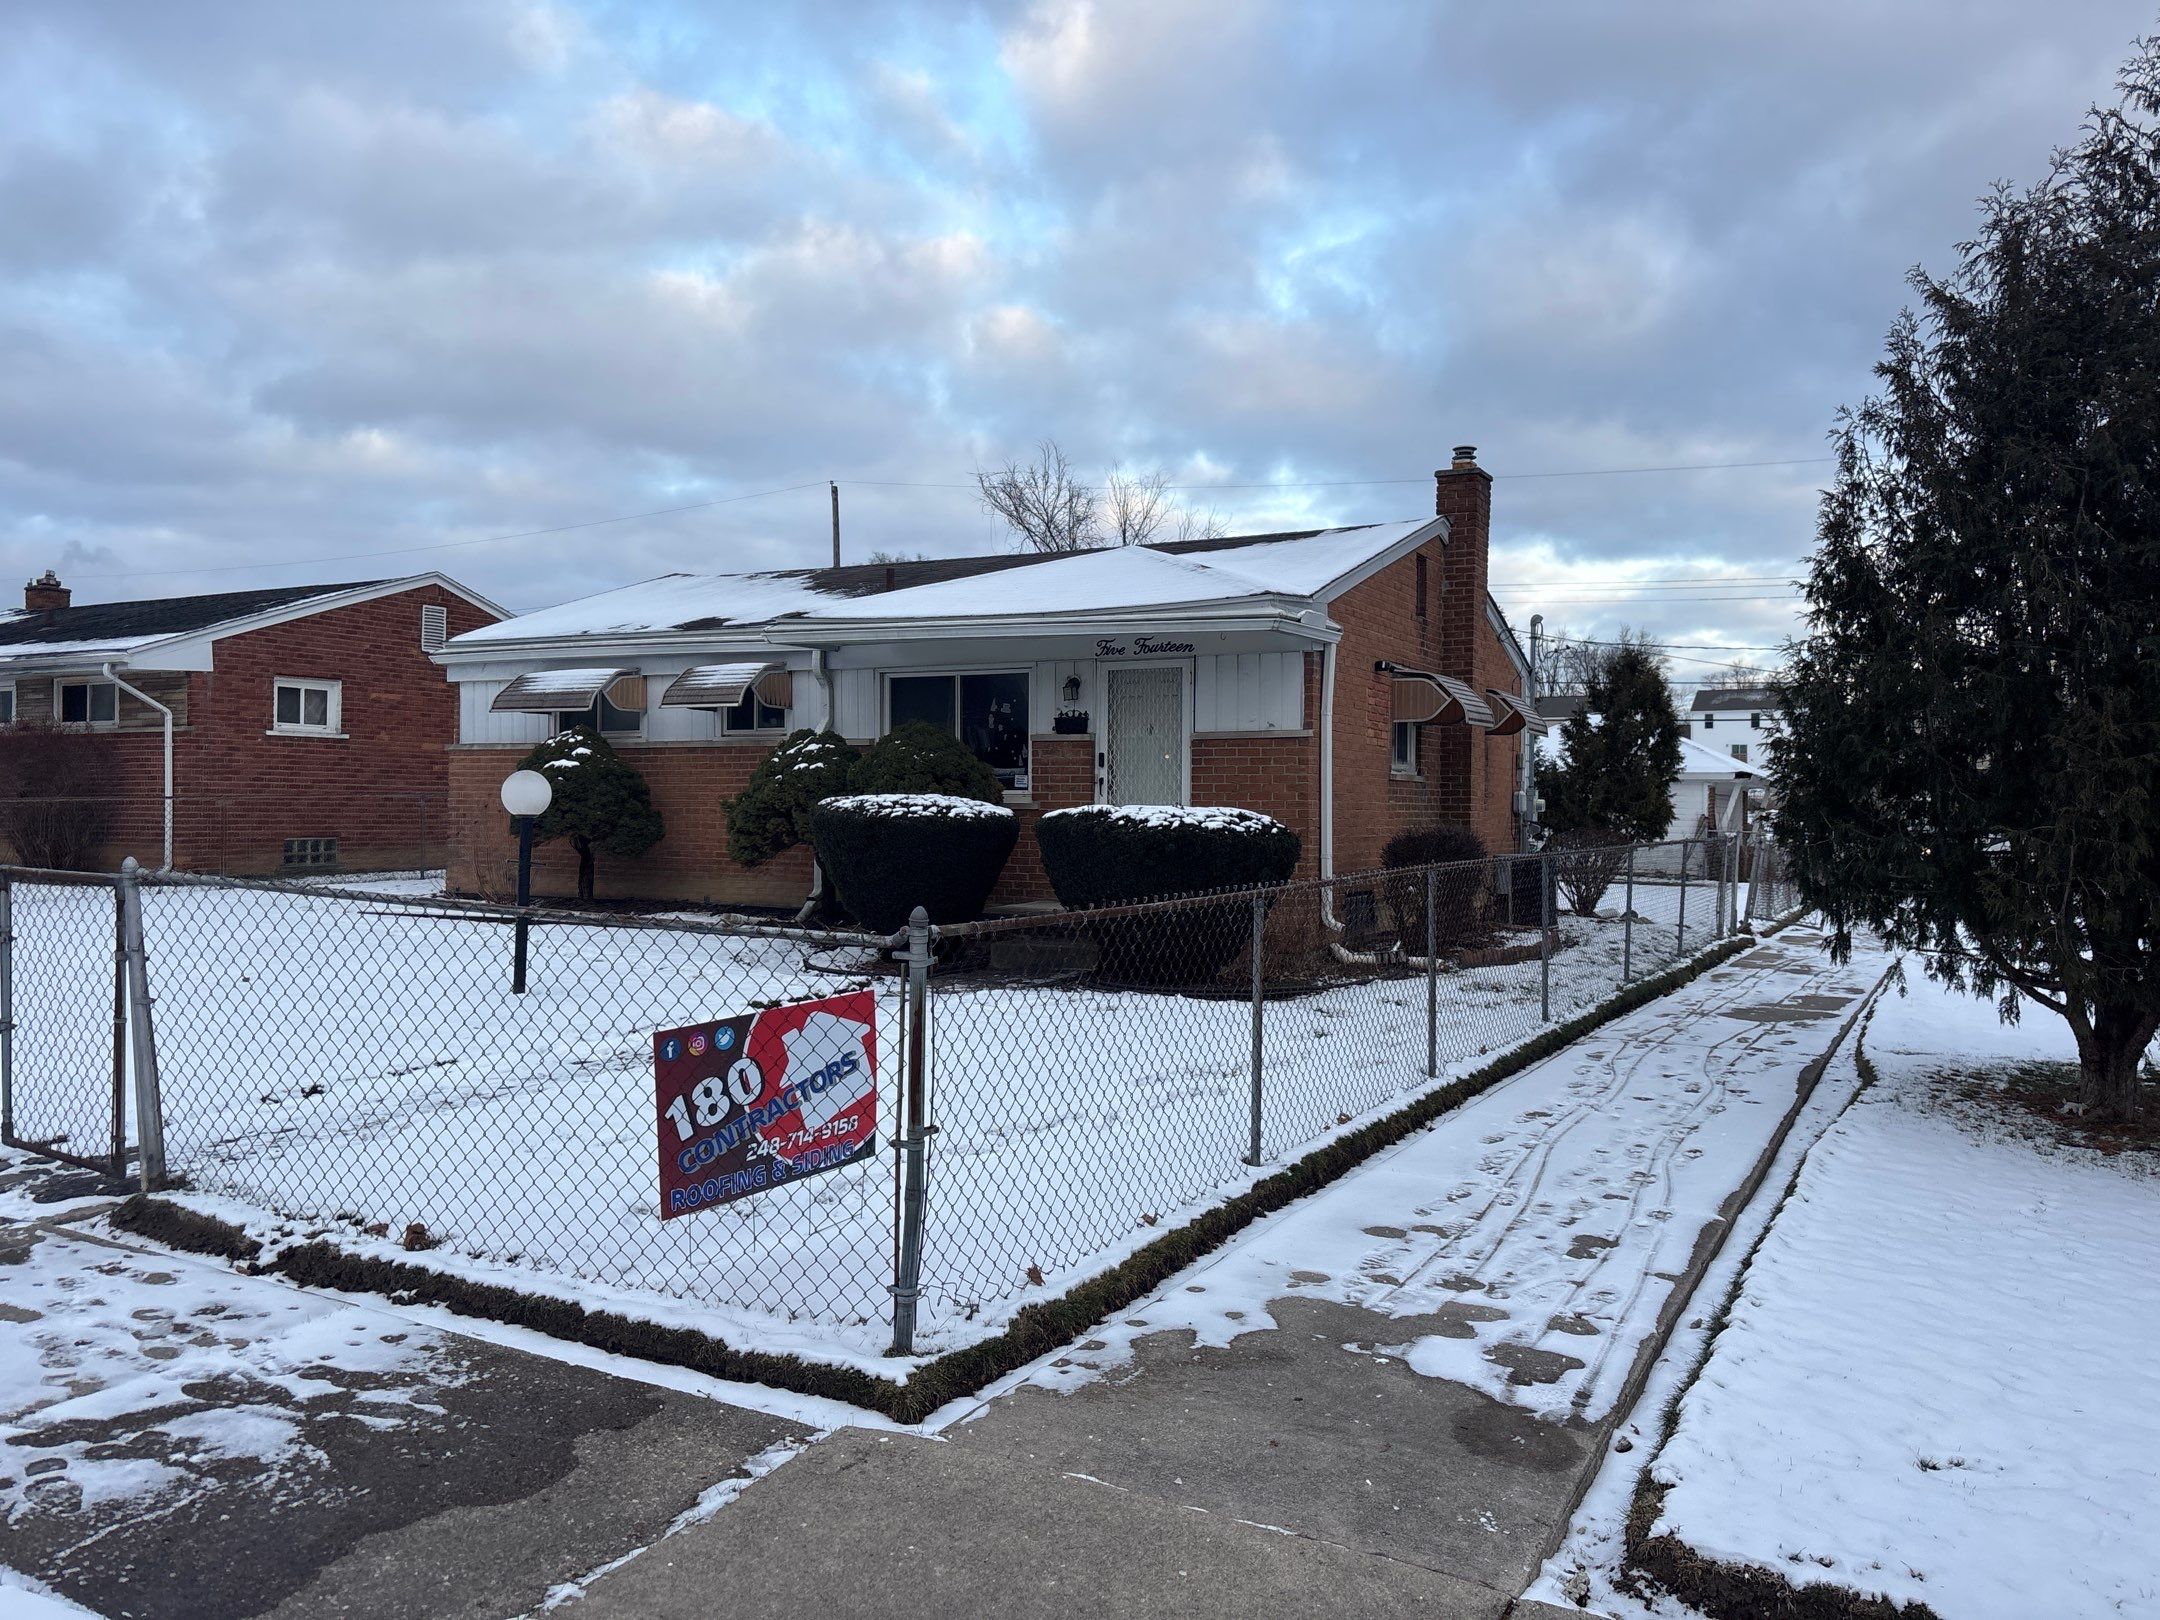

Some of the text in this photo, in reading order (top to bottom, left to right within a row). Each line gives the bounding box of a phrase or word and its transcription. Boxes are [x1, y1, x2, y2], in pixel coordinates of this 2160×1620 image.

[1095, 636, 1195, 657] Five Fourteen
[664, 1057, 764, 1142] 180
[678, 1050, 860, 1175] CONTRACTORS
[671, 1139, 855, 1212] ROOFING & SIDING
